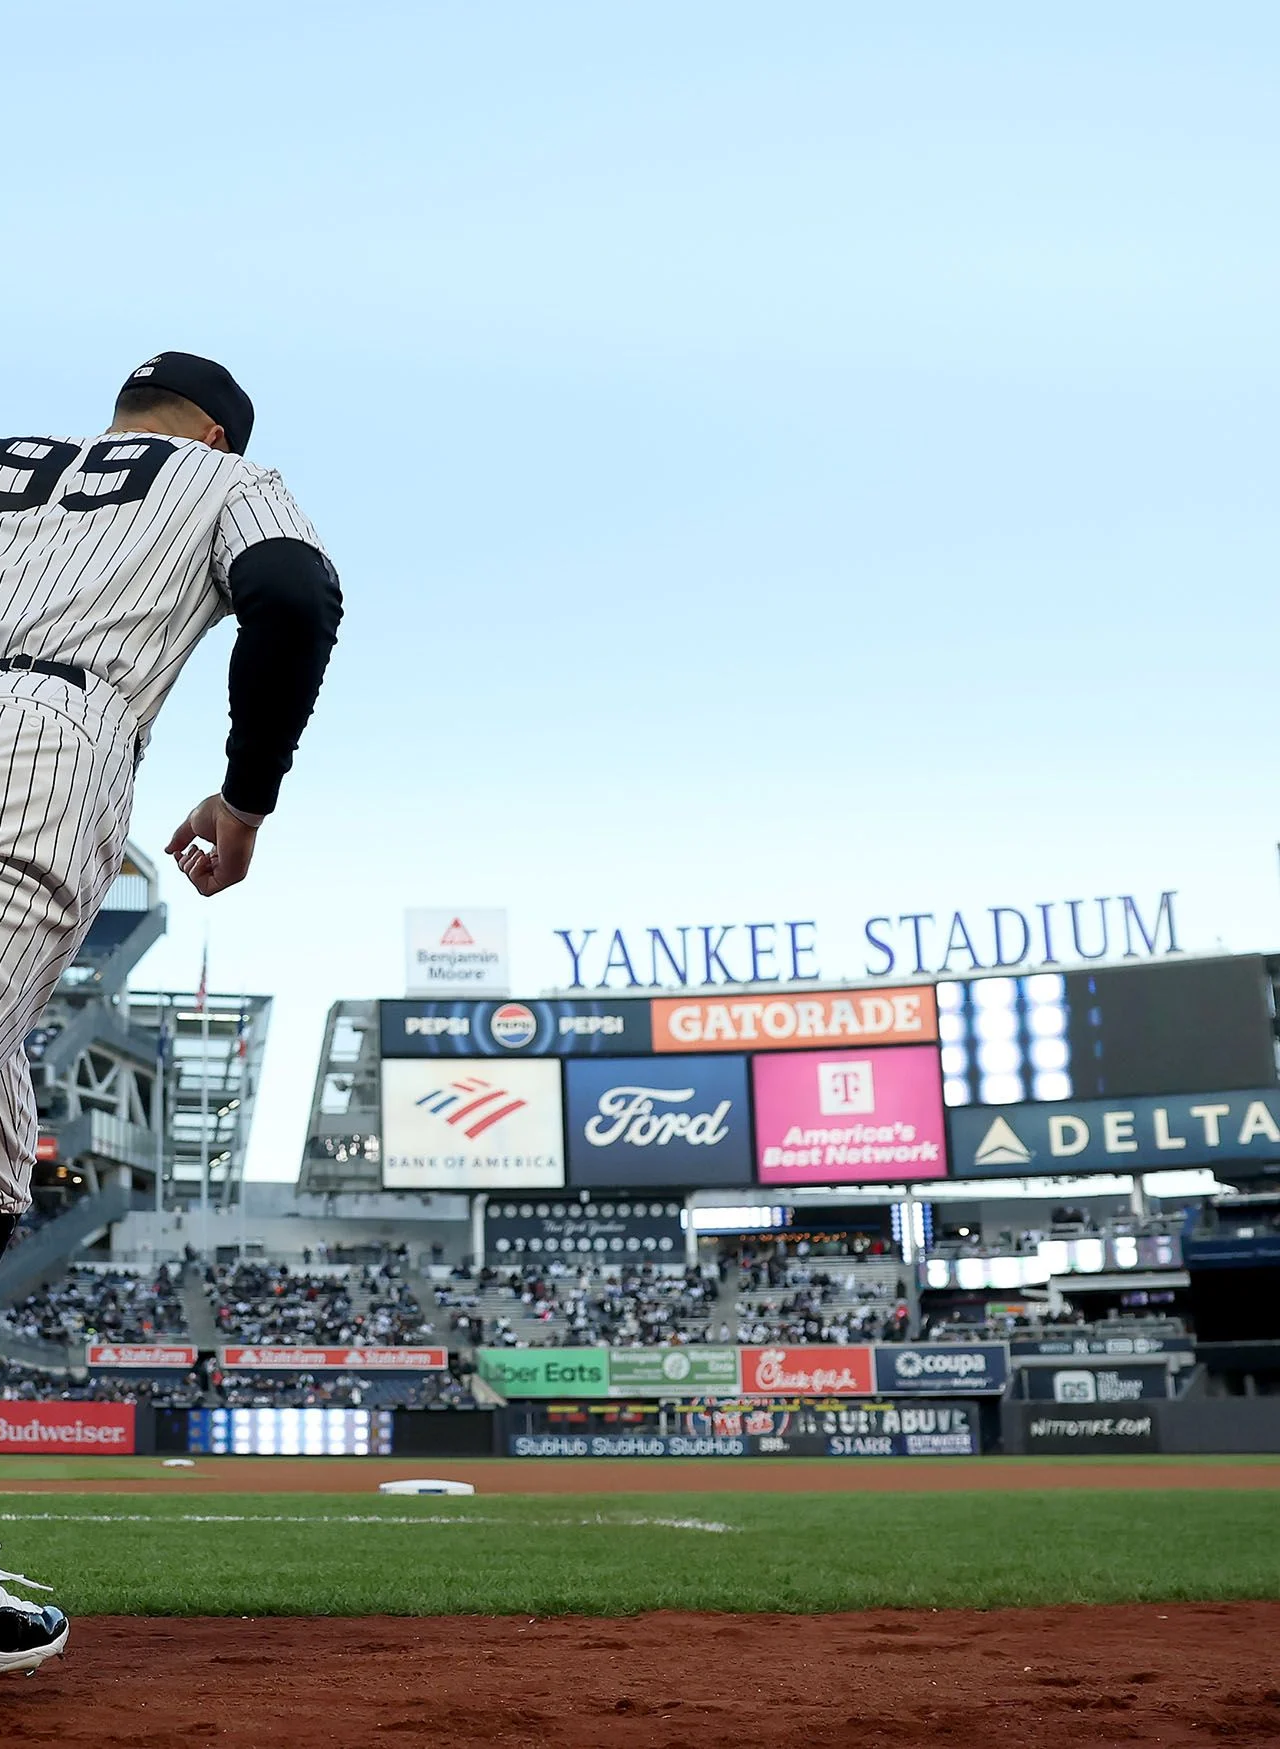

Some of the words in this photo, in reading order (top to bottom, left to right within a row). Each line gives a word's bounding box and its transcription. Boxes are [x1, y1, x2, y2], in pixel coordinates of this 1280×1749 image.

[553, 921, 820, 988] YANKEE
[865, 890, 1183, 977] STADIUM
[416, 950, 499, 966] Benjamin
[428, 967, 485, 979] Moore
[405, 1016, 469, 1035] PEPSI
[559, 1016, 624, 1035] PEPSI
[667, 994, 921, 1042] GATORADE
[585, 1086, 732, 1147] Ford
[782, 1121, 917, 1147] America's
[1047, 1100, 1280, 1158] DELTA
[388, 1156, 438, 1169] BANK
[444, 1156, 466, 1168] OF
[472, 1156, 558, 1169] AMERICA
[763, 1146, 822, 1168] Best
[825, 1141, 940, 1166] Network
[544, 1362, 602, 1383] Eats
[923, 1354, 986, 1377] coupa
[515, 1437, 588, 1456] StubHub
[592, 1437, 665, 1456] StubHub
[671, 1437, 744, 1455] StubHub
[830, 1436, 893, 1456] STARR
